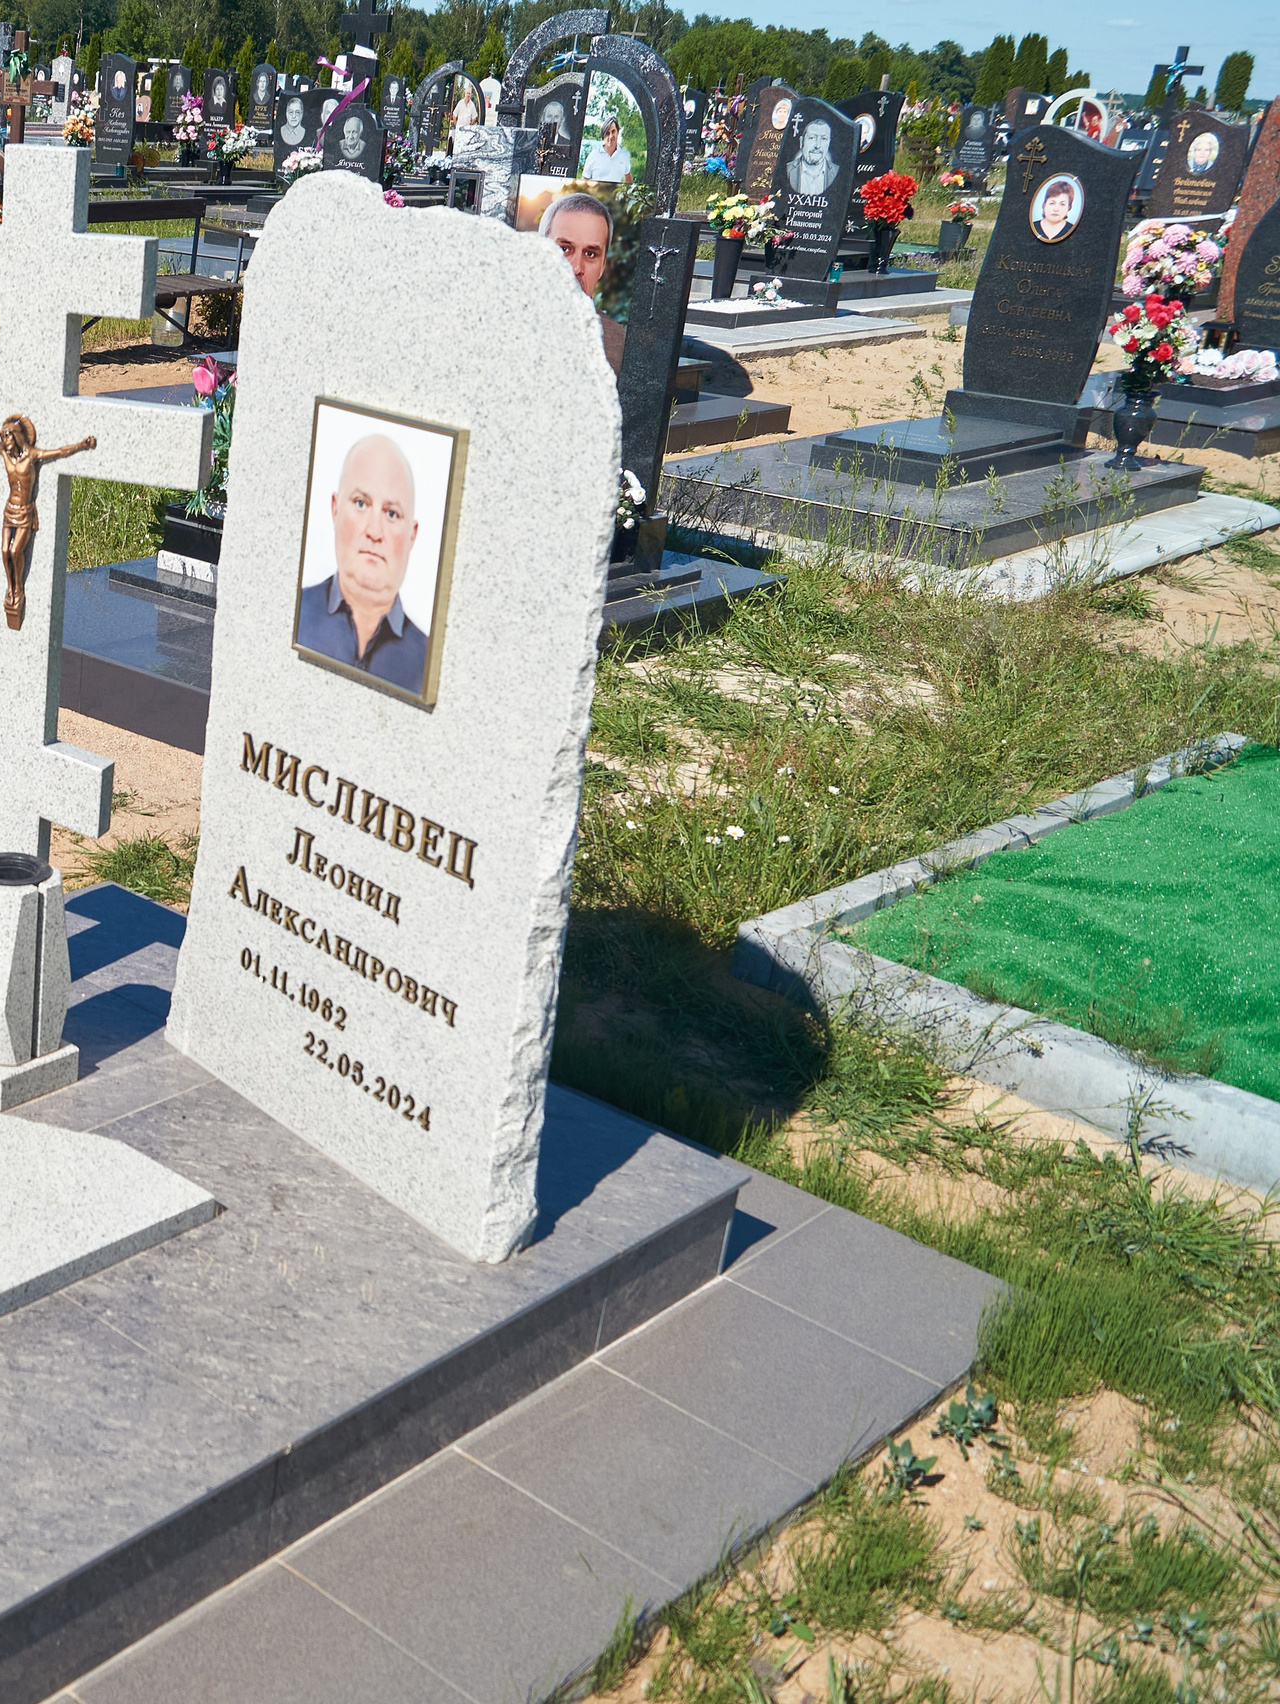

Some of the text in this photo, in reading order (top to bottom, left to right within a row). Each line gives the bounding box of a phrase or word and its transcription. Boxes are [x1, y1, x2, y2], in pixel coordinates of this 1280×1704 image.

[785, 217, 823, 229] Иванович
[787, 193, 829, 208] УХАНЬ
[788, 206, 823, 219] Григорий
[997, 299, 1072, 322] Сергеевна
[1016, 278, 1061, 298] Ольга
[239, 731, 479, 890] МИСЛИВЕЦ
[286, 826, 402, 926] Леонид
[227, 865, 459, 1029] Александрович
[240, 947, 348, 1032] 01.11.1962
[303, 1031, 431, 1132] 22.05.2024
